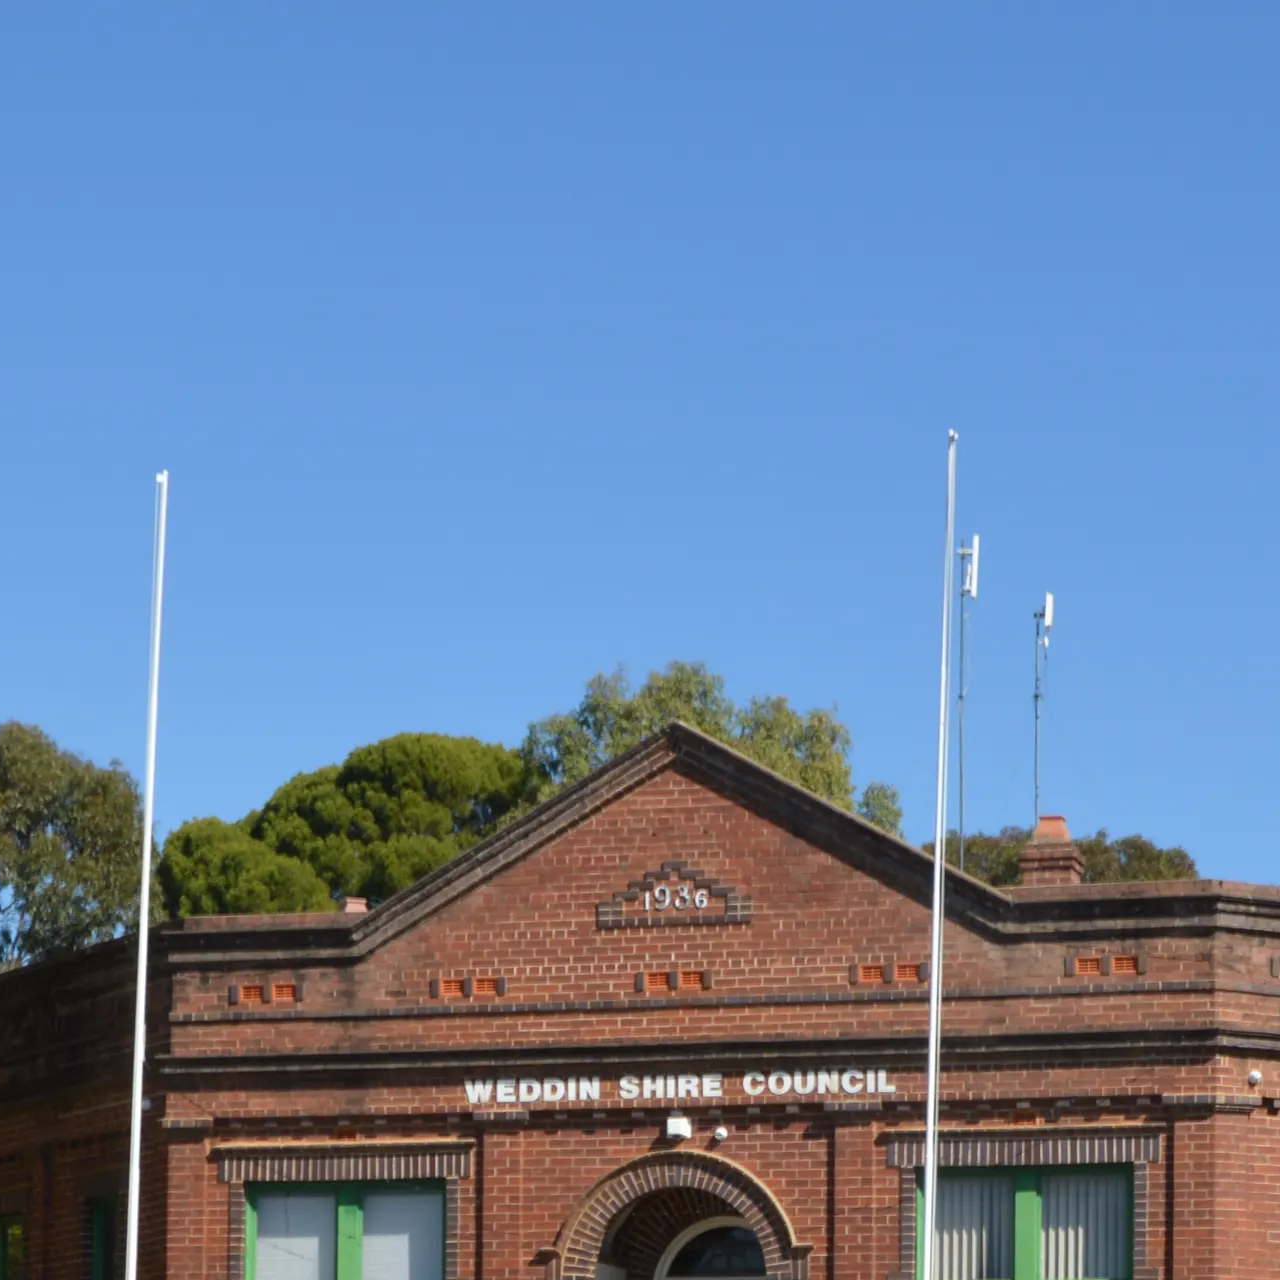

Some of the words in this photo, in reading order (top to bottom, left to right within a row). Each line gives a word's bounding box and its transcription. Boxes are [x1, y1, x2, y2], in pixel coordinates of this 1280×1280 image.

[644, 885, 709, 911] 1936
[464, 1077, 601, 1104] WEDDIN
[619, 1074, 723, 1100] SHIRE
[743, 1069, 896, 1096] COUNCIL
